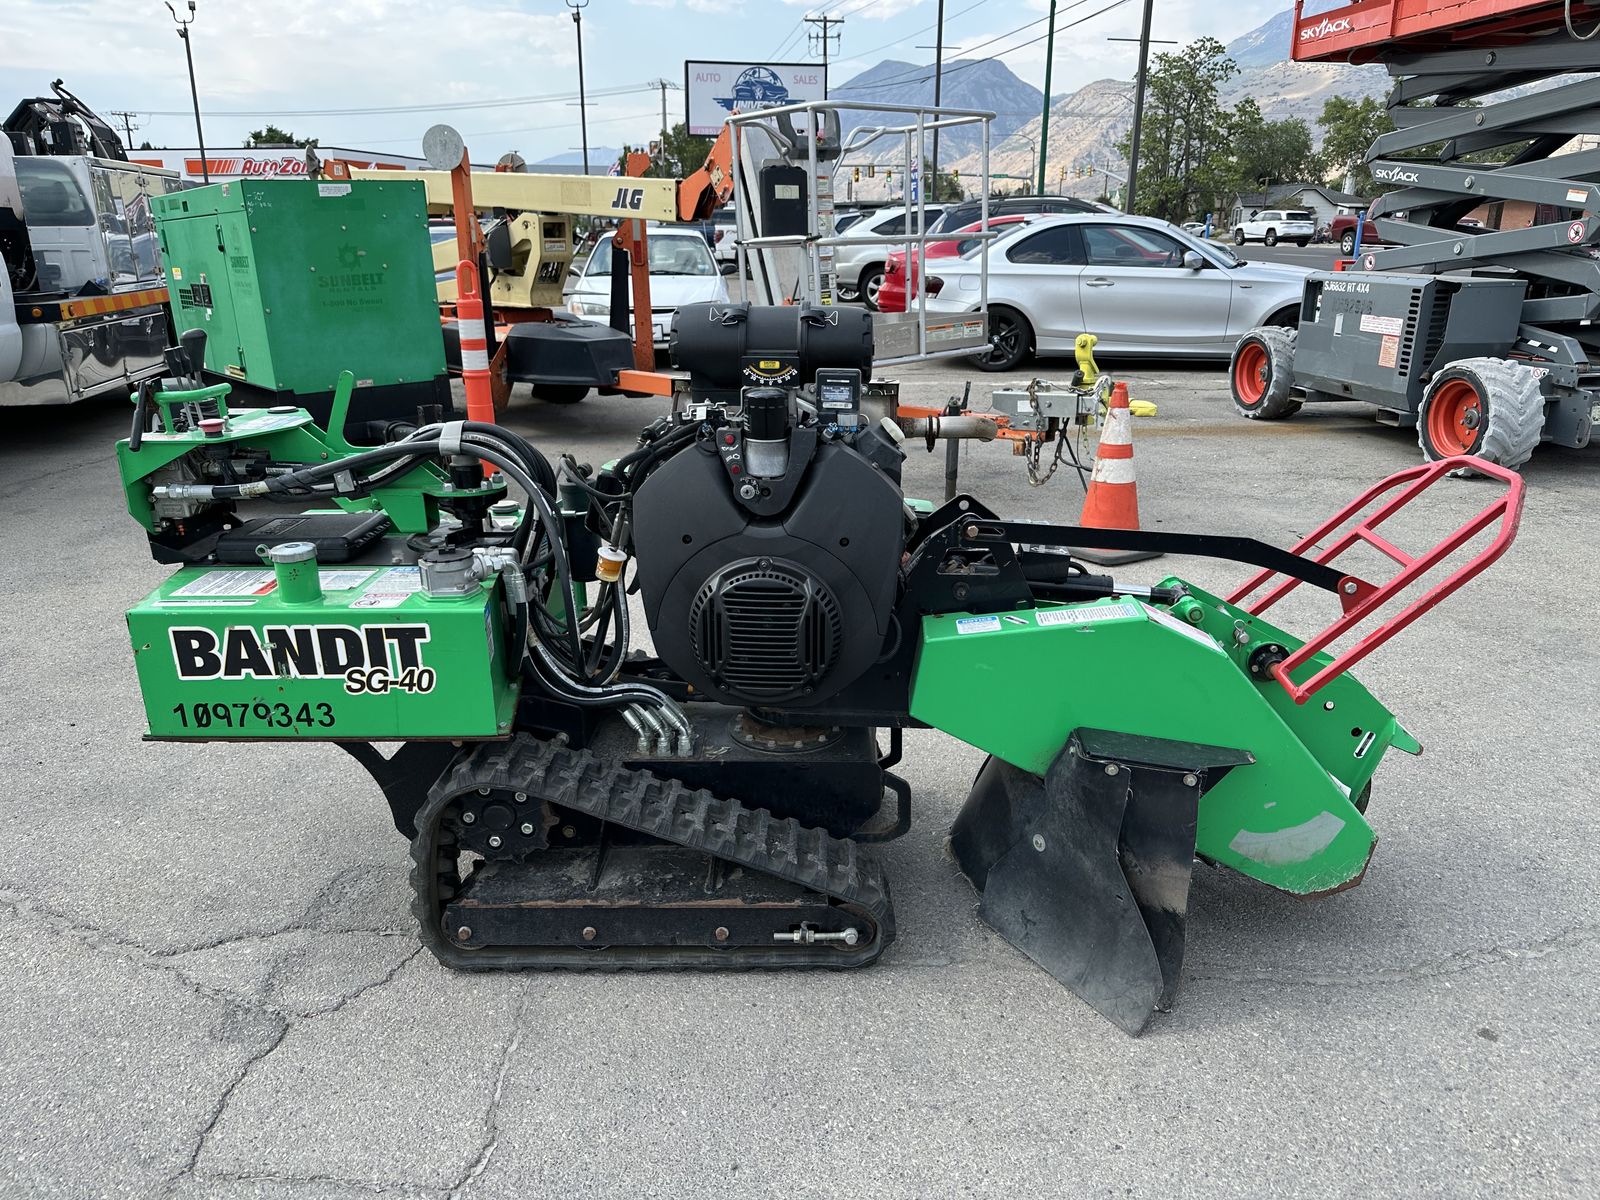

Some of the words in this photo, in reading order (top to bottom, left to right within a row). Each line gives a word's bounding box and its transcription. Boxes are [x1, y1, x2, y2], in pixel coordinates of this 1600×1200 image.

[1300, 17, 1350, 40] SKYJACK
[696, 73, 721, 82] AUTO
[793, 75, 818, 85] SALES
[733, 100, 786, 110] UNIVE
[242, 157, 308, 174] AutoZon
[1375, 166, 1419, 183] SKYJACK
[611, 187, 645, 210] JLG
[318, 272, 385, 288] SUNBELT
[1347, 282, 1356, 292] RT
[1356, 283, 1370, 293] 4X4
[170, 626, 429, 679] BANDIT
[345, 668, 435, 694] SG-40
[173, 702, 336, 728] 10979343
